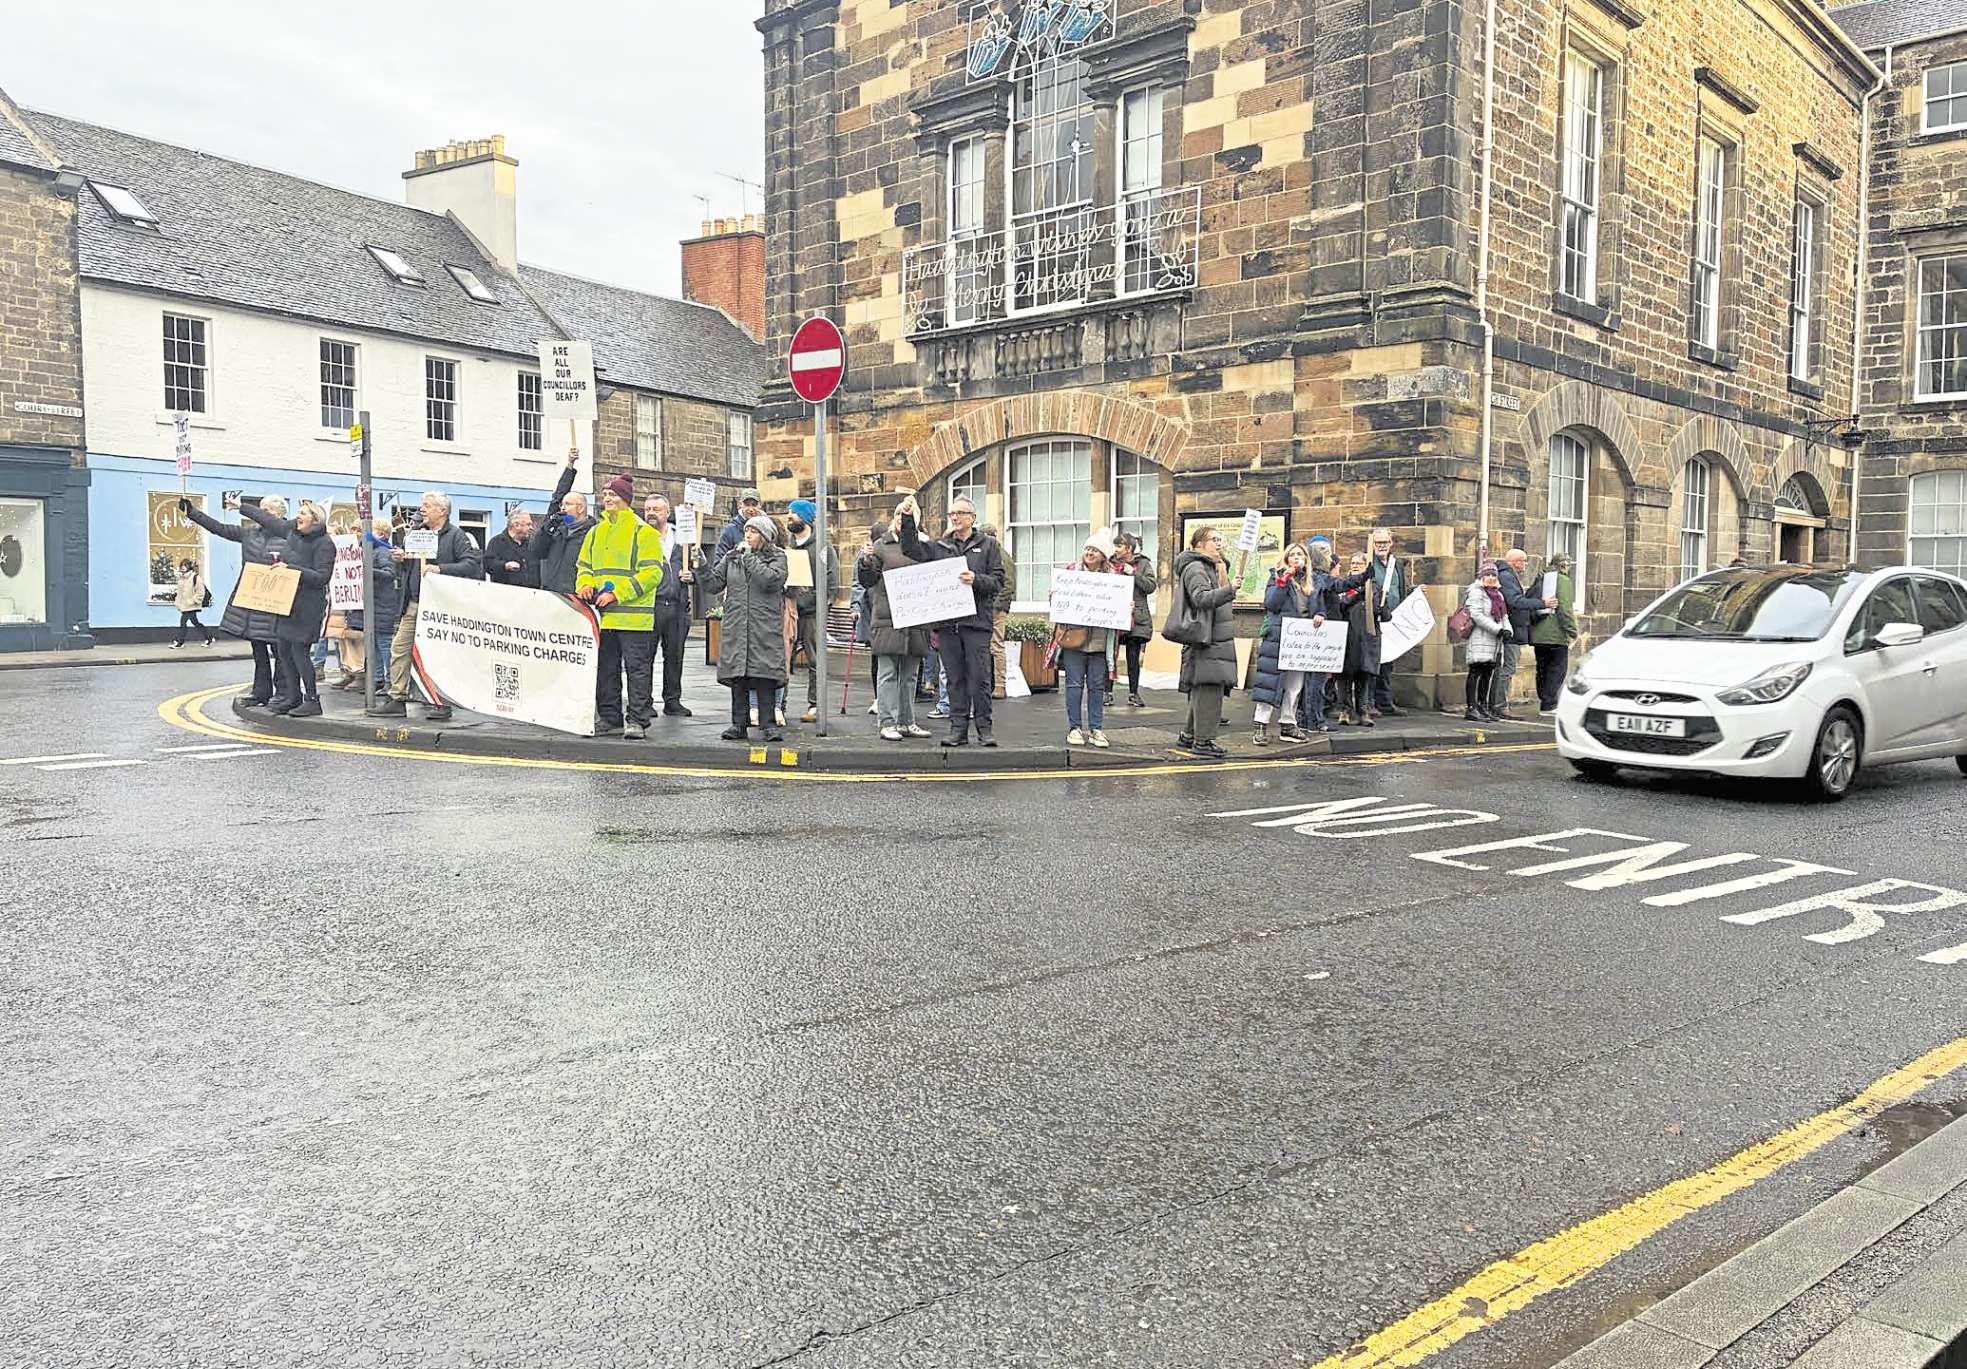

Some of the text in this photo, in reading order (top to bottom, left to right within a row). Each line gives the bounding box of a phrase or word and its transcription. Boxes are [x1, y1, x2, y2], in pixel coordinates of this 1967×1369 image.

[552, 346, 569, 356] ARE
[554, 358, 569, 367] ALL
[555, 369, 572, 378] OUR
[543, 380, 586, 390] COUNCILLORS
[555, 392, 579, 401] DEAF?
[421, 610, 594, 649] SAVE HADDINGTON TOWN CENTRE
[426, 627, 587, 666] SAY NO TO PARKING CHARGES
[1617, 716, 1673, 733] EA11 AZF
[1203, 796, 1501, 839] NO
[1410, 827, 1967, 963] ENTR
